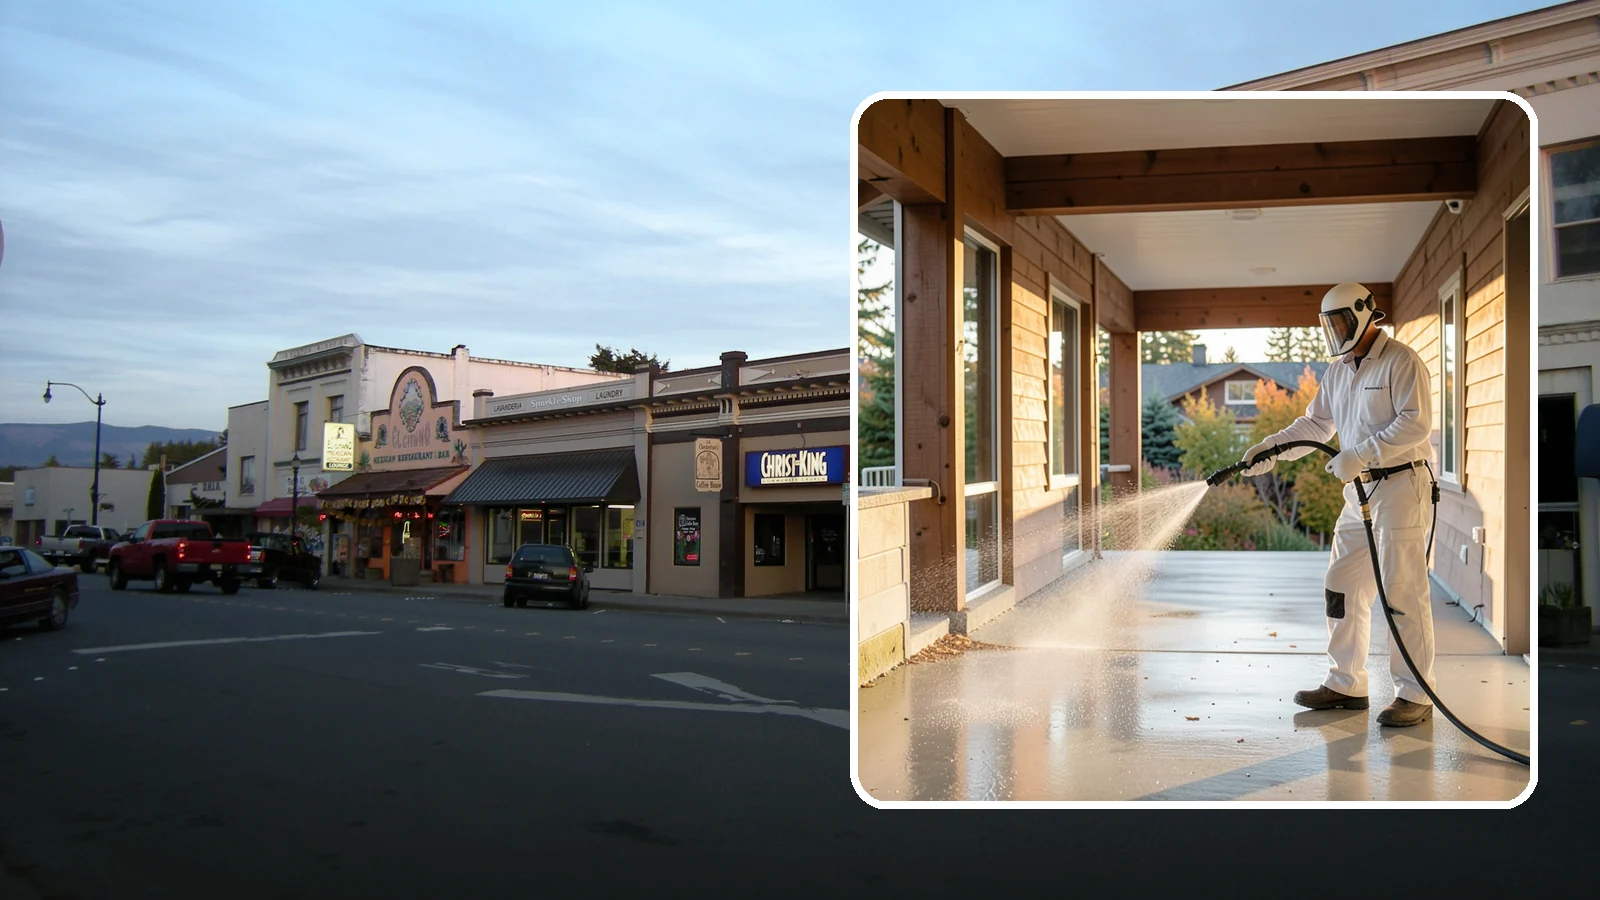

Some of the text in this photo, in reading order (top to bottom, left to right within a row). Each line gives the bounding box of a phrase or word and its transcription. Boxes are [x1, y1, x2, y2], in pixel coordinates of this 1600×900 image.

[595, 389, 623, 400] LAUNDRY
[493, 402, 522, 412] LAVANDERIA
[530, 394, 583, 409] Sparkle Shop
[373, 454, 396, 464] MEXICAN
[397, 451, 433, 462] RESTAURANT
[438, 450, 450, 459] BAR
